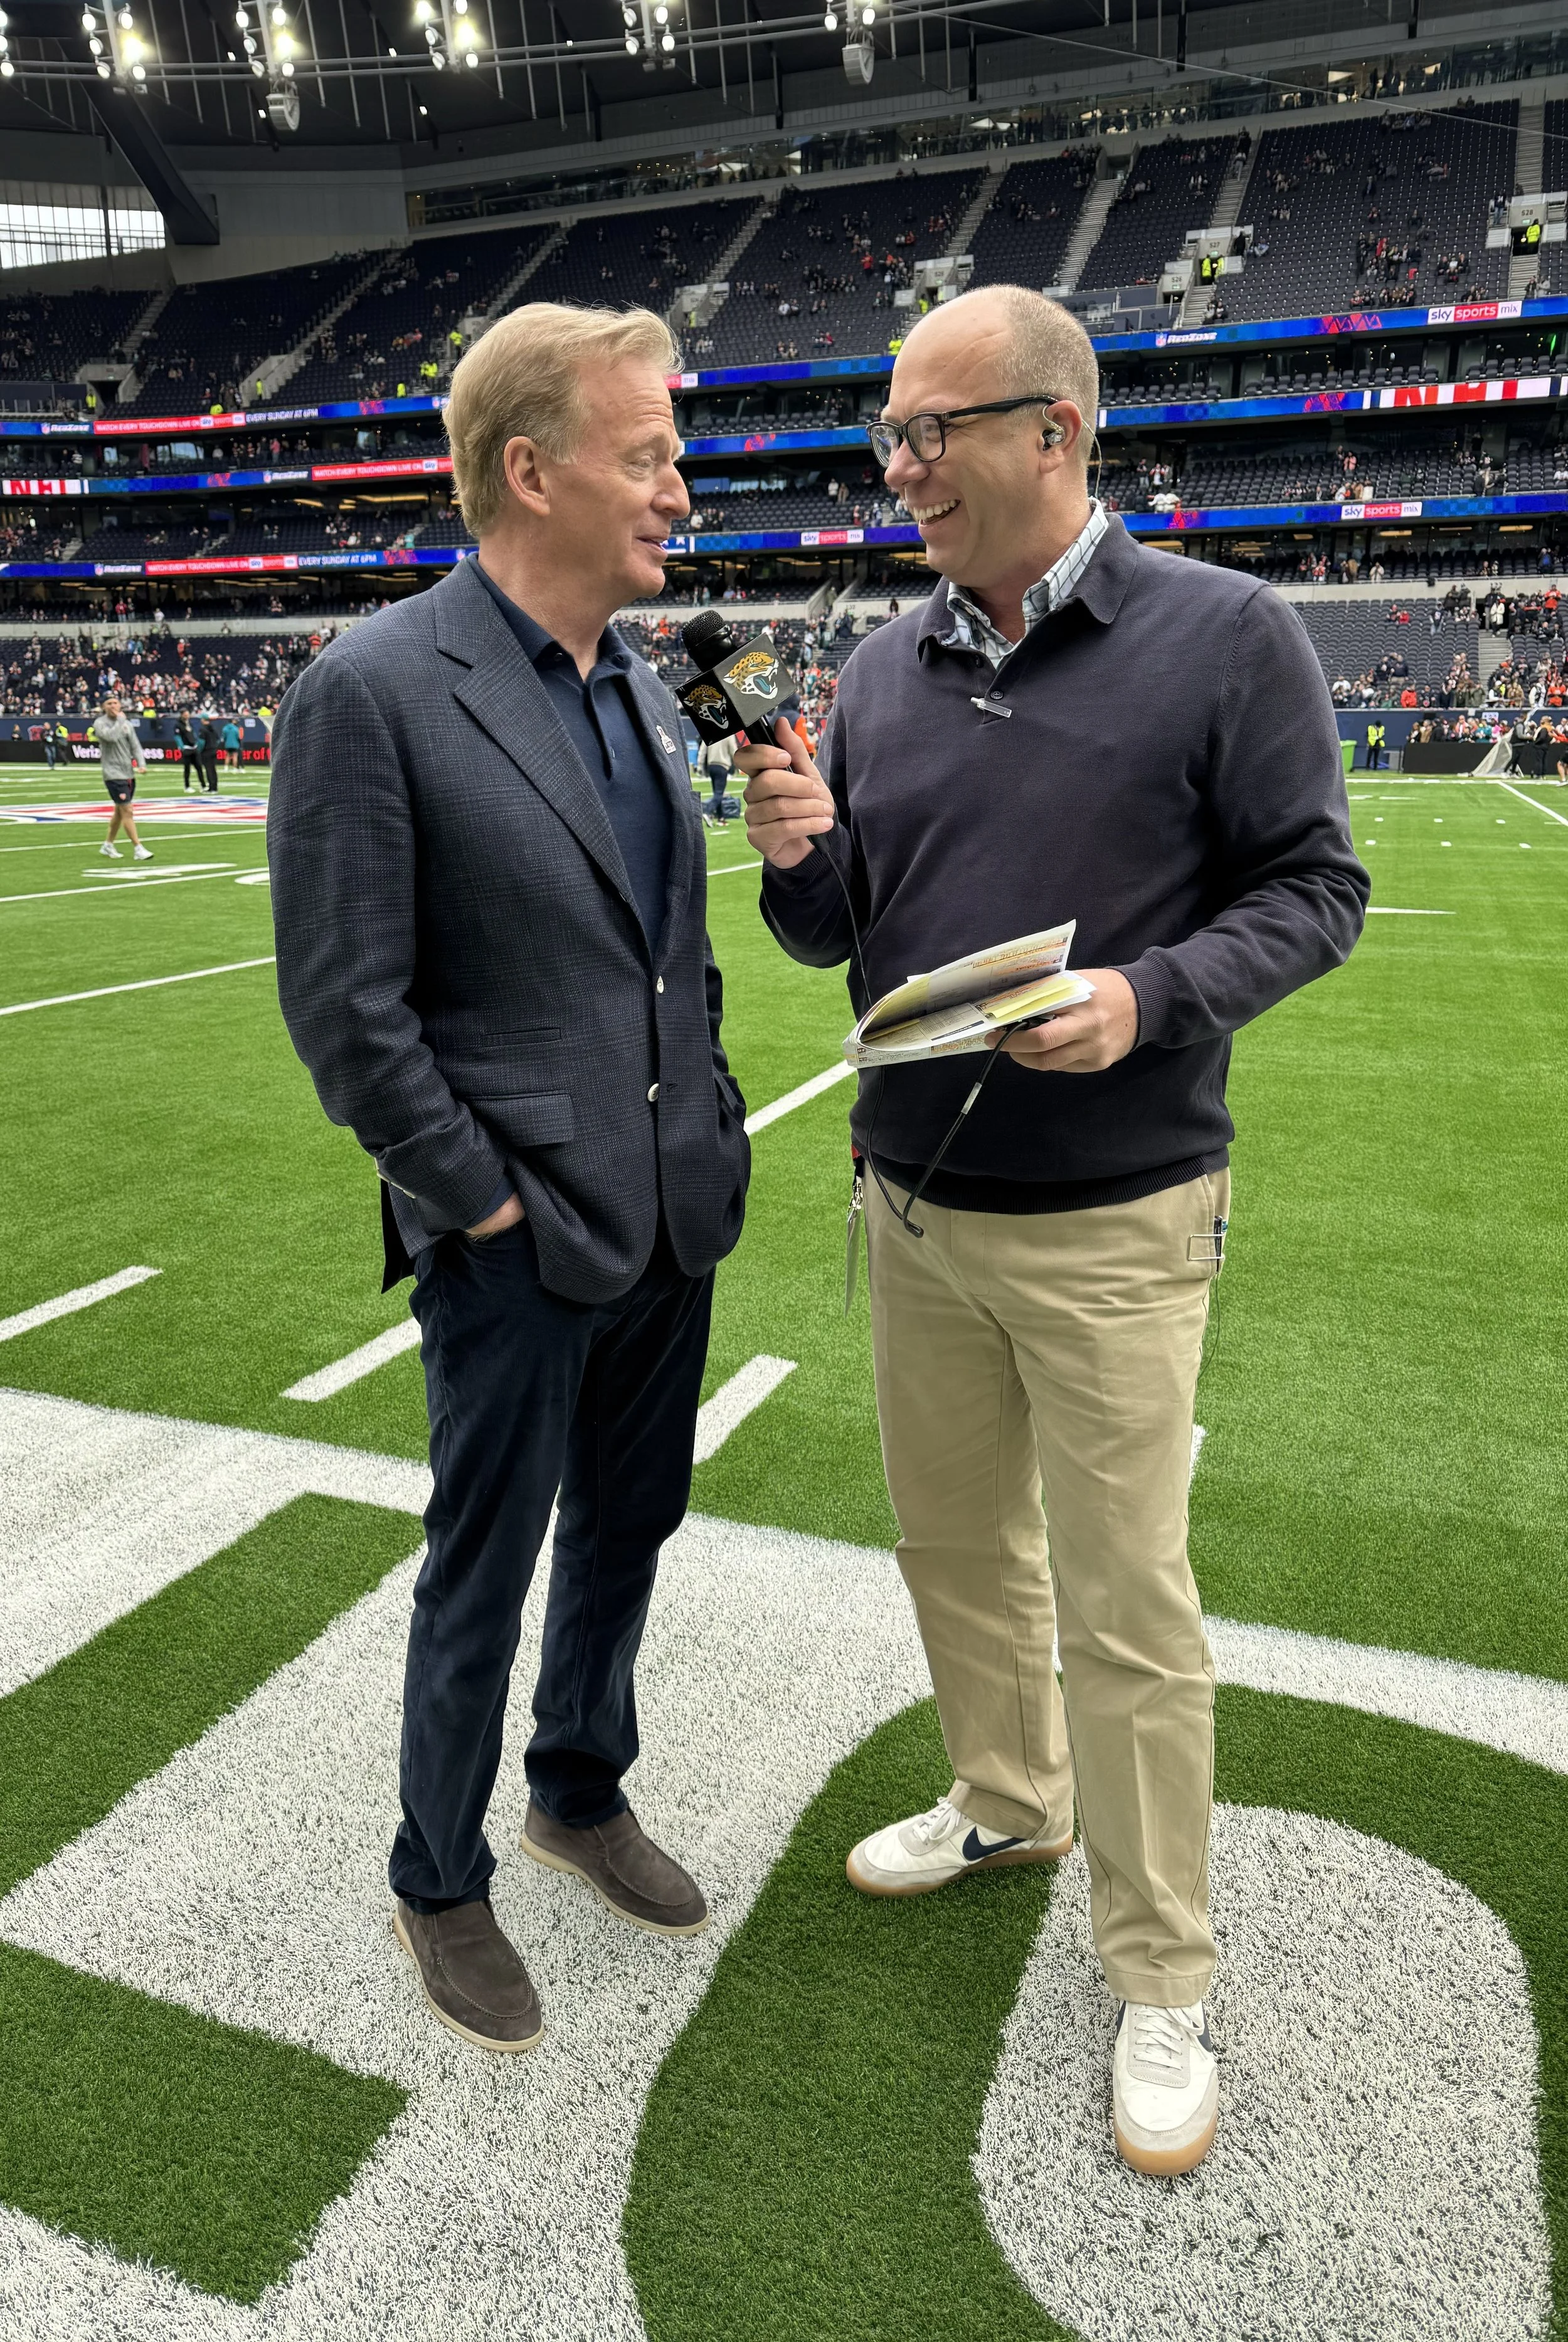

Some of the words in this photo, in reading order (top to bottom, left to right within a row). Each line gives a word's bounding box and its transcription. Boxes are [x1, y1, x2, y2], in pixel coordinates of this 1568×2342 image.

[1431, 308, 1452, 321] sky
[1456, 305, 1496, 321] sports
[1501, 304, 1518, 314] mix
[246, 413, 267, 423] EVERY
[267, 411, 294, 421] SUNDAY
[294, 410, 303, 418] AT
[1345, 506, 1362, 517] sky
[1365, 506, 1401, 517] sports
[804, 534, 817, 543] sky
[298, 556, 320, 566] EVERY
[320, 555, 351, 564] SUNDAY
[351, 554, 360, 563] AT
